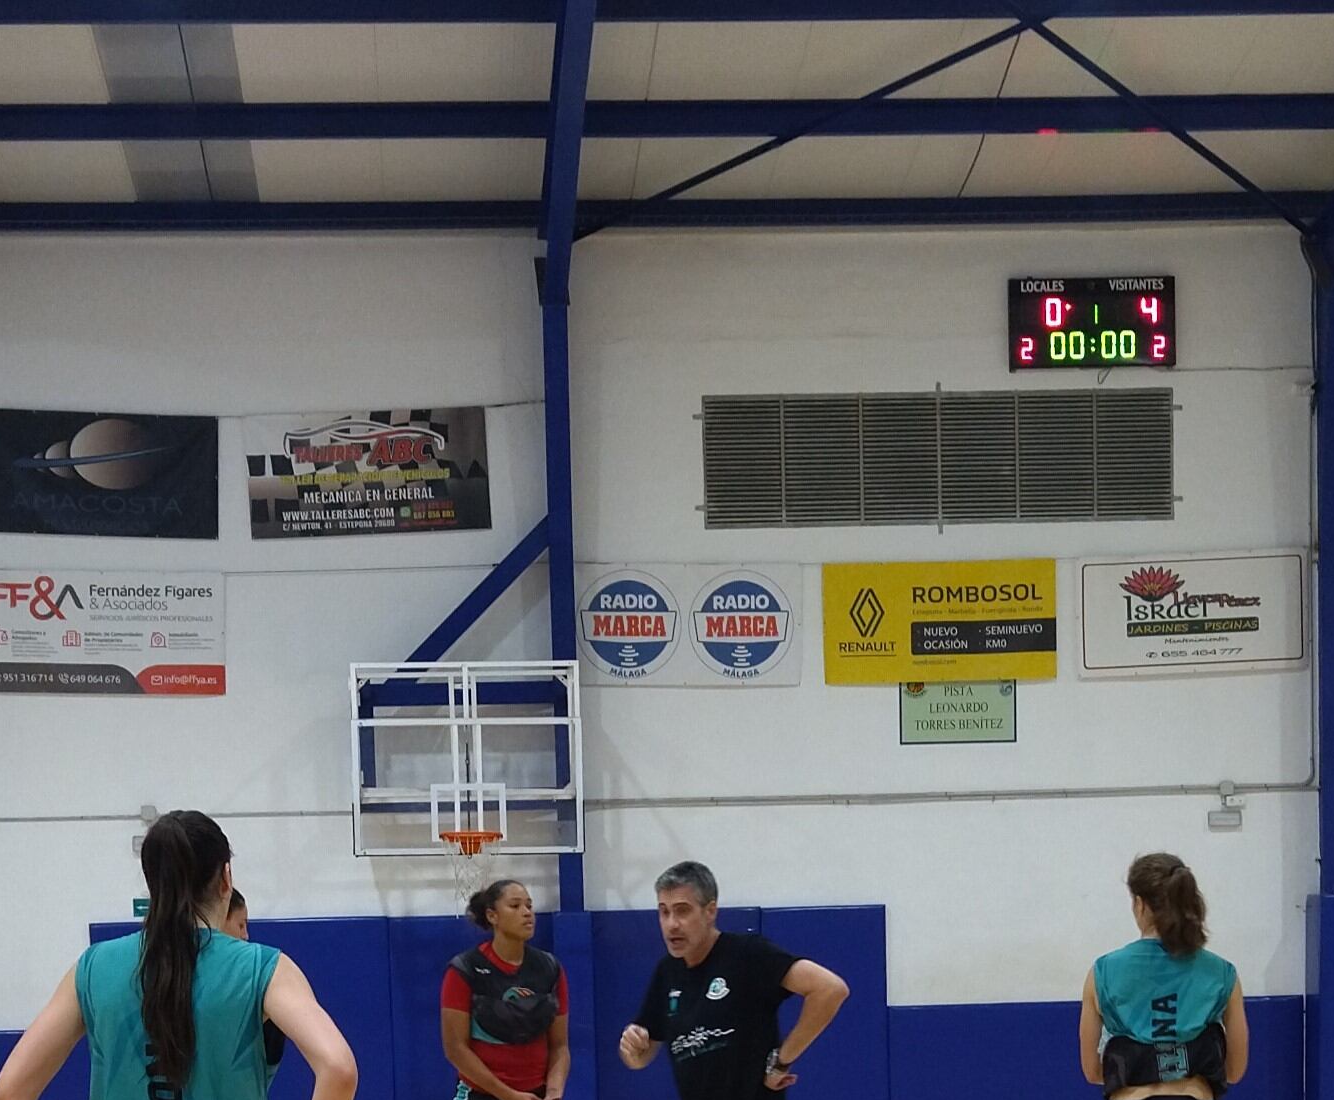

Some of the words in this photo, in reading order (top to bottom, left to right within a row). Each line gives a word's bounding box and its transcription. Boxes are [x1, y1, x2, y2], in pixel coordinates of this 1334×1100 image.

[1020, 280, 1065, 293] LOCALES
[1108, 278, 1164, 292] VISITANTES
[1140, 297, 1158, 324] 4
[1020, 337, 1034, 360] 2
[1050, 330, 1136, 360] 00:00
[1153, 335, 1165, 358] 2
[367, 436, 433, 465] ABC
[303, 489, 362, 504] MECANICA
[366, 489, 380, 501] EN
[384, 486, 435, 500] GENERAL
[282, 507, 394, 522] WWW.TALLERESABC.COM
[339, 521, 372, 529] ESTEPONA
[89, 584, 161, 598] Fernández
[912, 583, 1043, 604] ROMBOSOL
[90, 600, 100, 610] &
[102, 599, 168, 611] Asociados
[600, 594, 657, 610] RADIO
[713, 594, 769, 610] RADIO
[593, 615, 666, 637] MARCA
[706, 615, 779, 637] MARCA
[924, 626, 958, 637] NUEVO
[985, 624, 1043, 635] SEMINUEVO
[1128, 623, 1189, 634] JARDINES
[1204, 618, 1258, 631] PISCINAS
[839, 641, 896, 653] RENAULT
[924, 638, 968, 649] OCASIÓN
[1219, 647, 1243, 656] 777
[2, 673, 19, 683] 951
[20, 673, 37, 683] 316
[38, 673, 54, 683] 714
[70, 674, 86, 684] 649
[87, 674, 104, 684] 064
[105, 674, 121, 684] 676
[610, 668, 647, 679] MÁLAGA
[723, 668, 759, 679] MÁLAGA
[944, 685, 974, 697] PISTA
[929, 702, 989, 714] LEONARDO
[915, 719, 956, 731] TORRES
